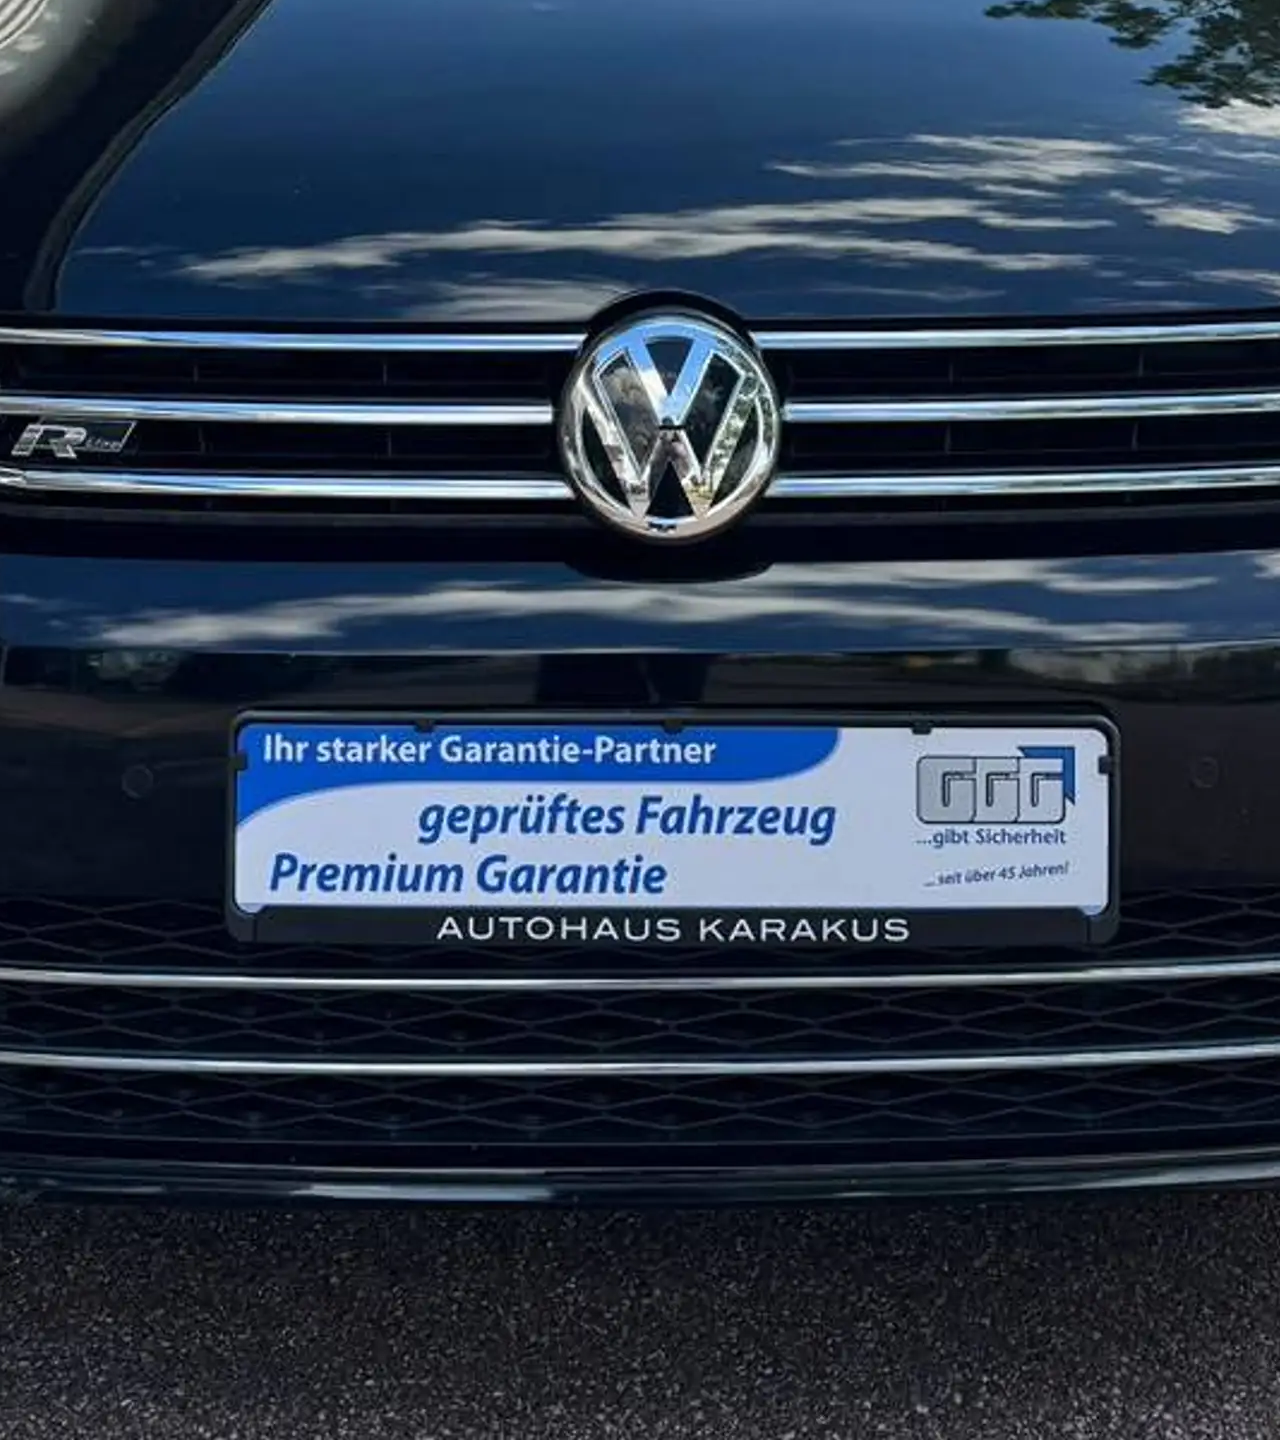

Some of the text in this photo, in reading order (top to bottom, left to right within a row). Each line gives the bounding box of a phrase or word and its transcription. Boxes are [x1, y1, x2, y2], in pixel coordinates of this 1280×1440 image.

[263, 733, 717, 764] Ihr starker Garantie-Partner
[417, 792, 837, 847] geprüftes Fahrzeug
[975, 828, 1067, 845] Sicherheit
[269, 852, 668, 895] Premium Garantie
[964, 867, 996, 884] über
[997, 865, 1017, 880] 45
[1019, 859, 1070, 879] Jahren!
[435, 916, 911, 942] AUTOHAUS KARAKUS
